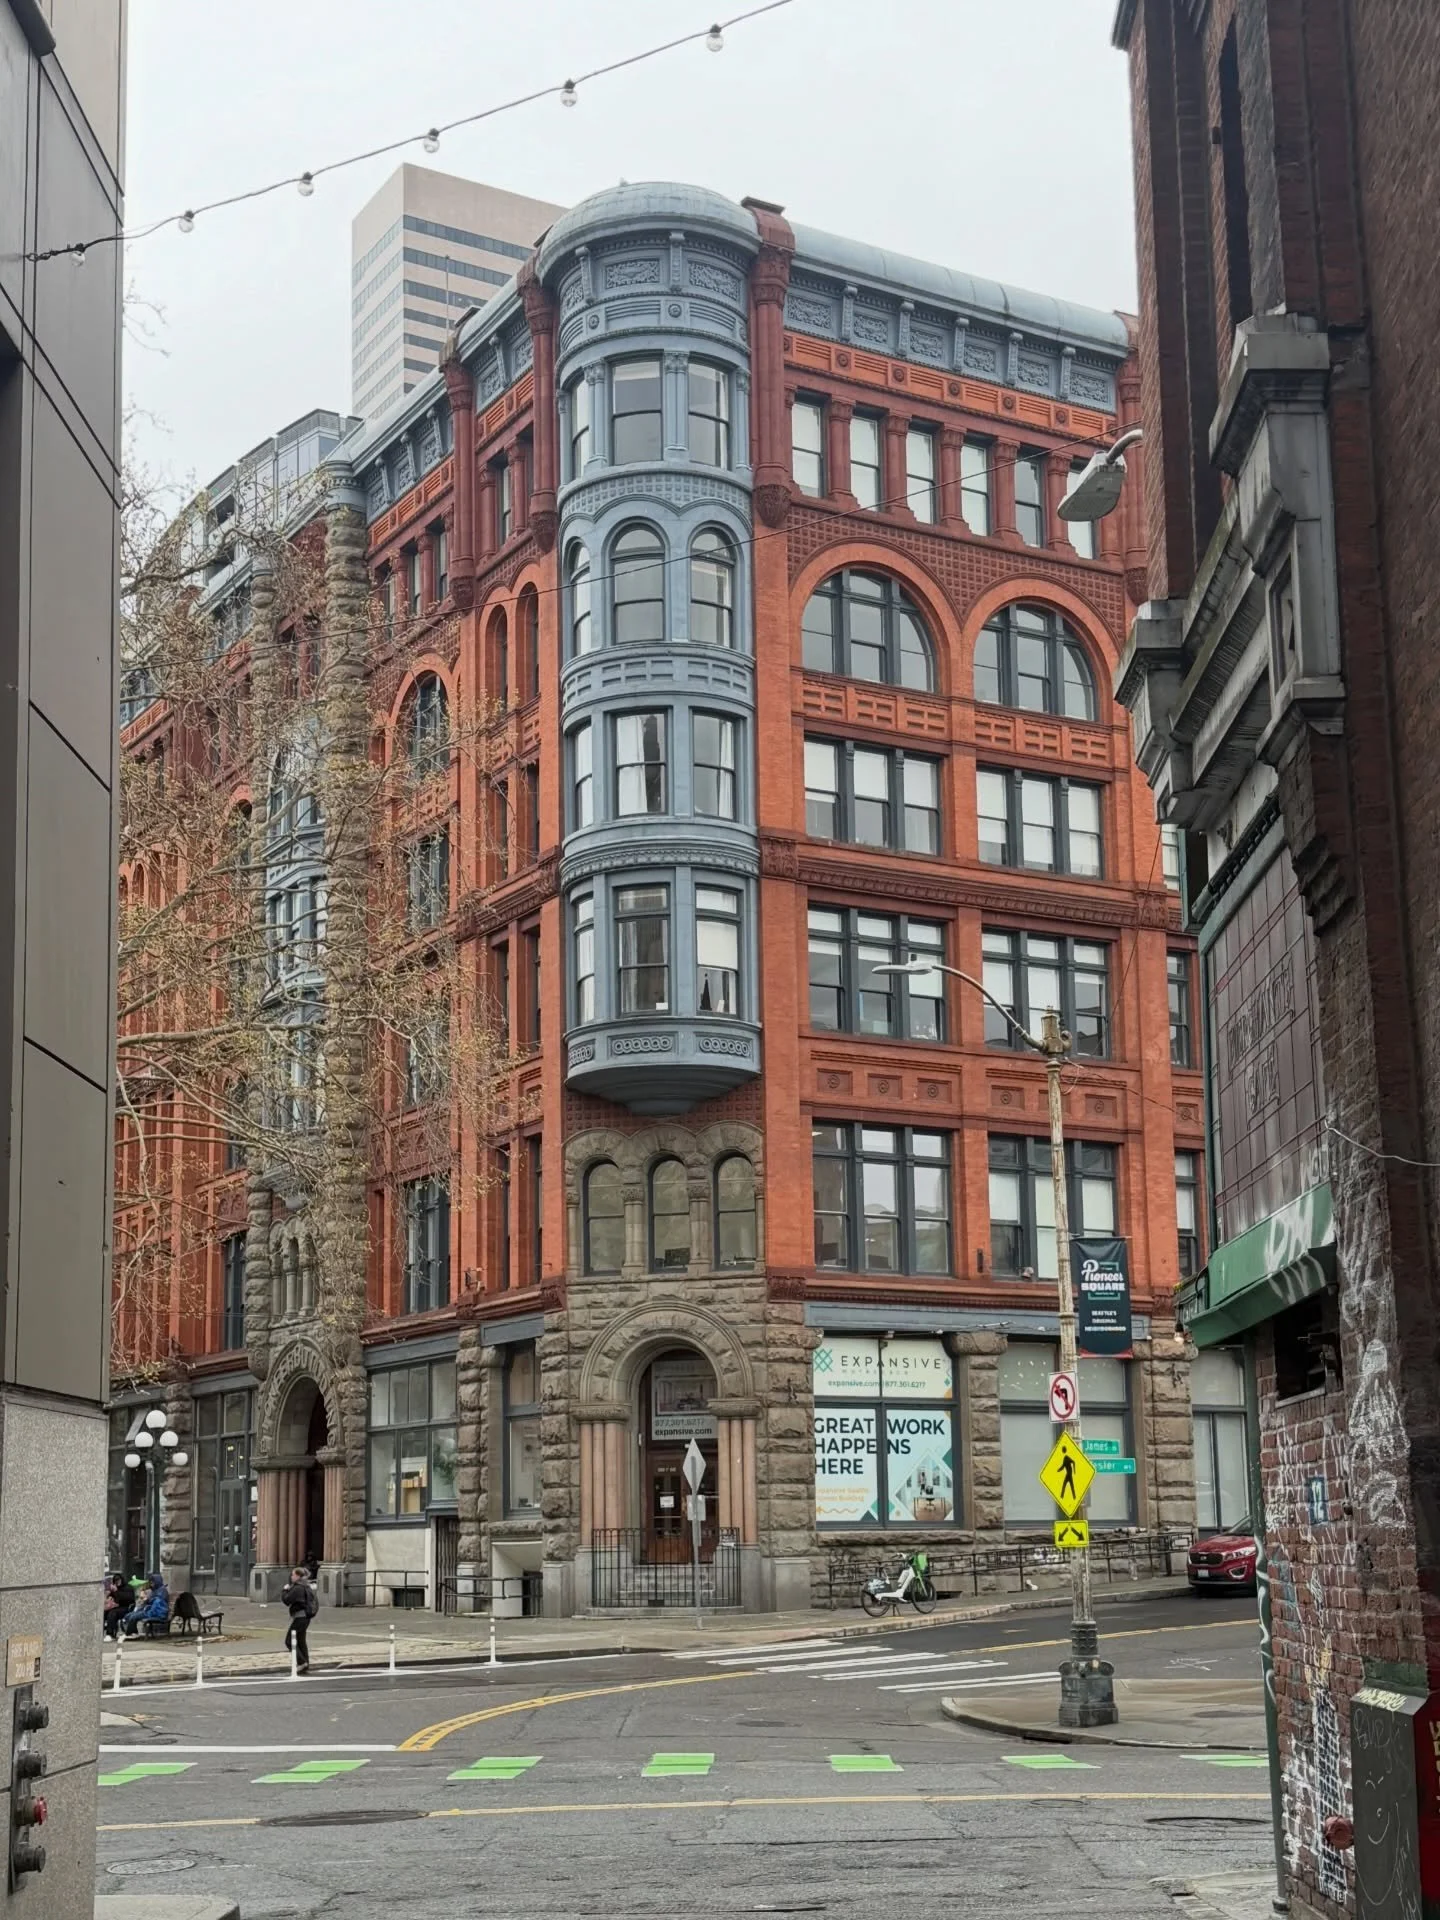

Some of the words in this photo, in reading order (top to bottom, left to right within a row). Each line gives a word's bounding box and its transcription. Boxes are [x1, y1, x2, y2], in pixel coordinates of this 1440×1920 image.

[1081, 1259, 1124, 1281] Pioneer
[1080, 1282, 1126, 1291] SQUARE
[841, 1355, 942, 1369] EXPANSIVE
[654, 1427, 713, 1436] expansive.com
[814, 1417, 875, 1434] GREAT
[887, 1418, 945, 1435] WORK
[1085, 1440, 1108, 1451] James
[814, 1458, 864, 1475] HERE
